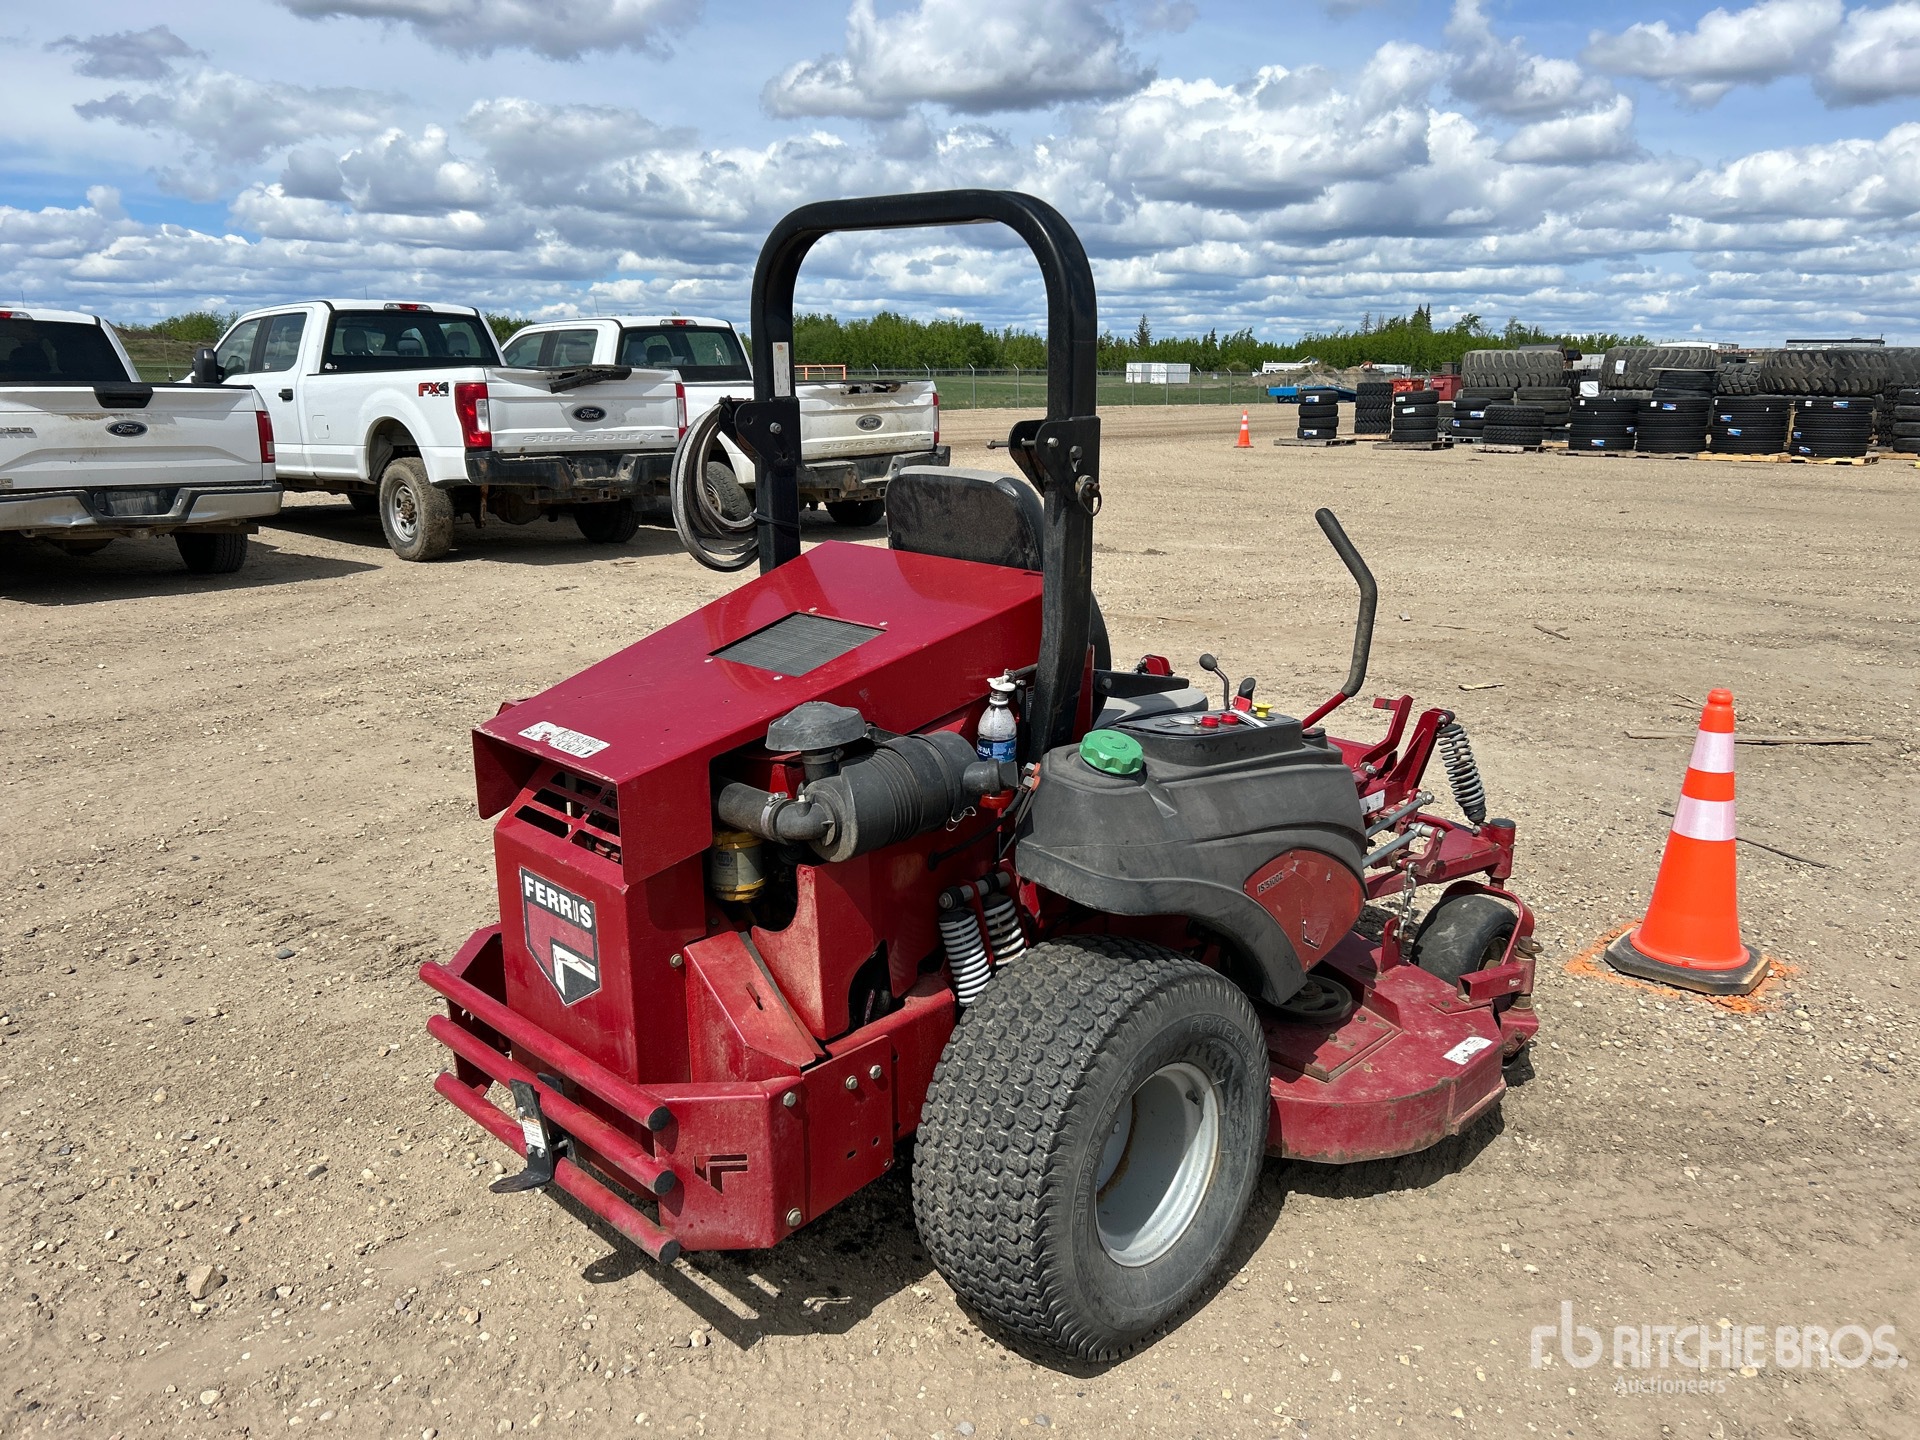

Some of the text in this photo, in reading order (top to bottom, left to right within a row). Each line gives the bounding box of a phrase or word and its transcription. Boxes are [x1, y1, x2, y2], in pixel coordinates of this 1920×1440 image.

[418, 381, 449, 397] FX4
[116, 423, 140, 434] Ford
[523, 433, 655, 443] SUPER DUTY
[821, 440, 876, 451] SUPER
[524, 875, 593, 929] FERRIS
